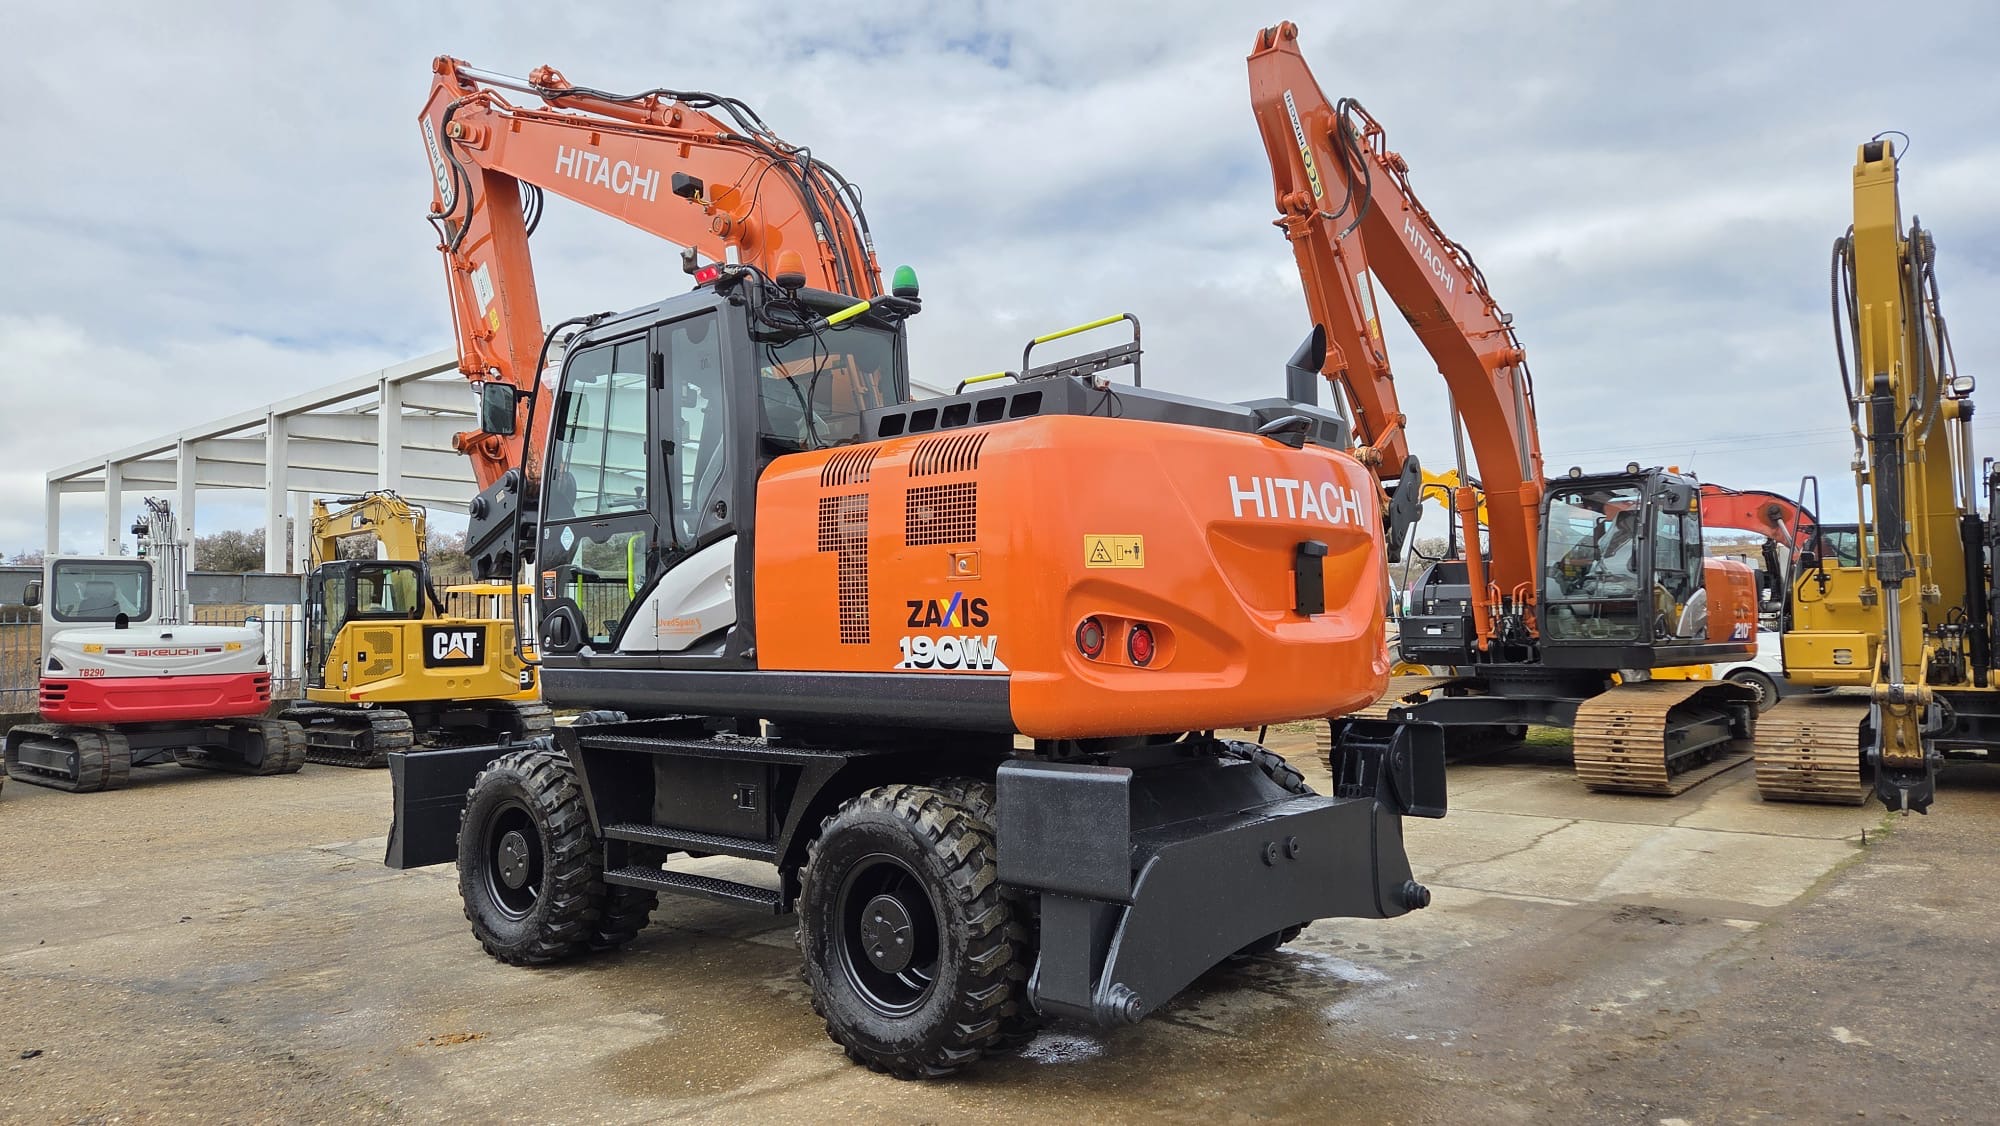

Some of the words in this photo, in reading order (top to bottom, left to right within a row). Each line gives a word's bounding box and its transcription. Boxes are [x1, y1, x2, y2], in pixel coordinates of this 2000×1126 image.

[424, 119, 438, 163] HITACHI
[1286, 94, 1304, 146] HITACHI
[555, 145, 660, 202] HITACHI
[1404, 217, 1454, 293] HITACHI
[1228, 475, 1365, 526] HITACHI
[907, 591, 990, 628] ZAXIS
[433, 632, 477, 660] CAT
[900, 635, 998, 669] 190W
[79, 668, 105, 677] TB290
